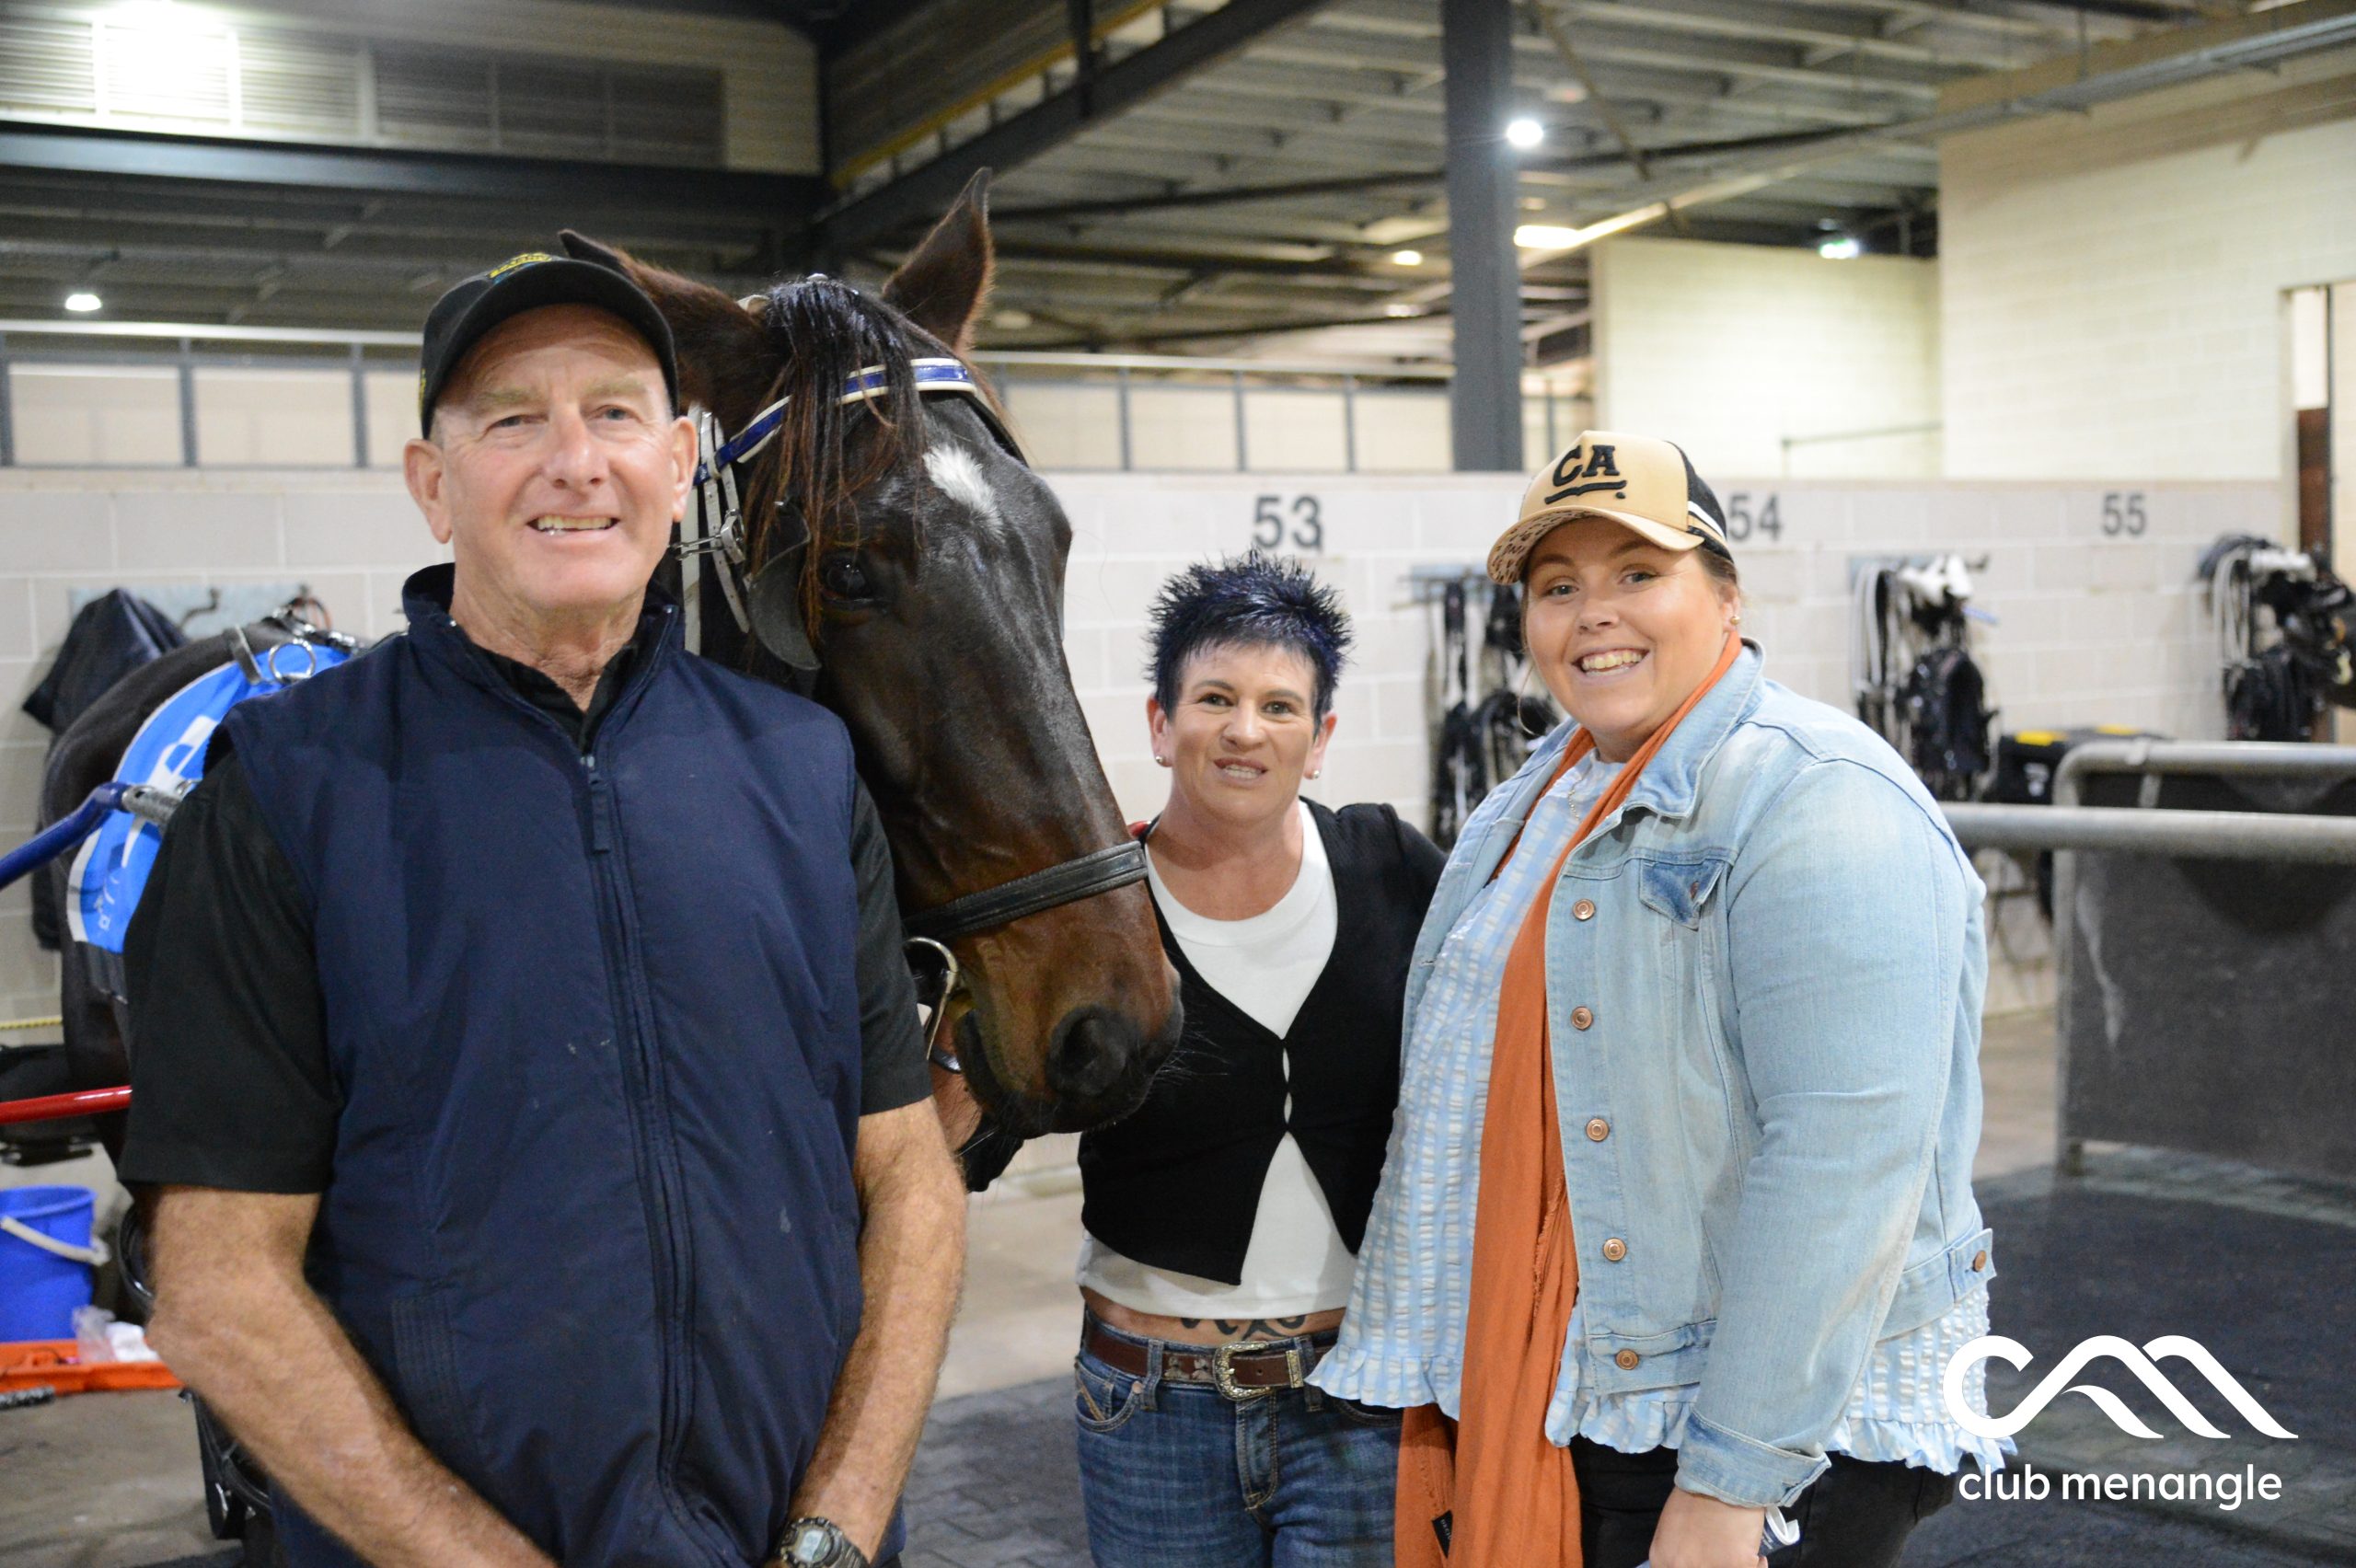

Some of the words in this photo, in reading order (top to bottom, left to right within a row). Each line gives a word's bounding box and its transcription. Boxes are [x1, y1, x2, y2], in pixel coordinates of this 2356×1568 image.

[1553, 444, 1621, 487] CA
[1253, 495, 1322, 552] 53
[1728, 494, 1784, 541] 54
[2102, 493, 2147, 536] 55
